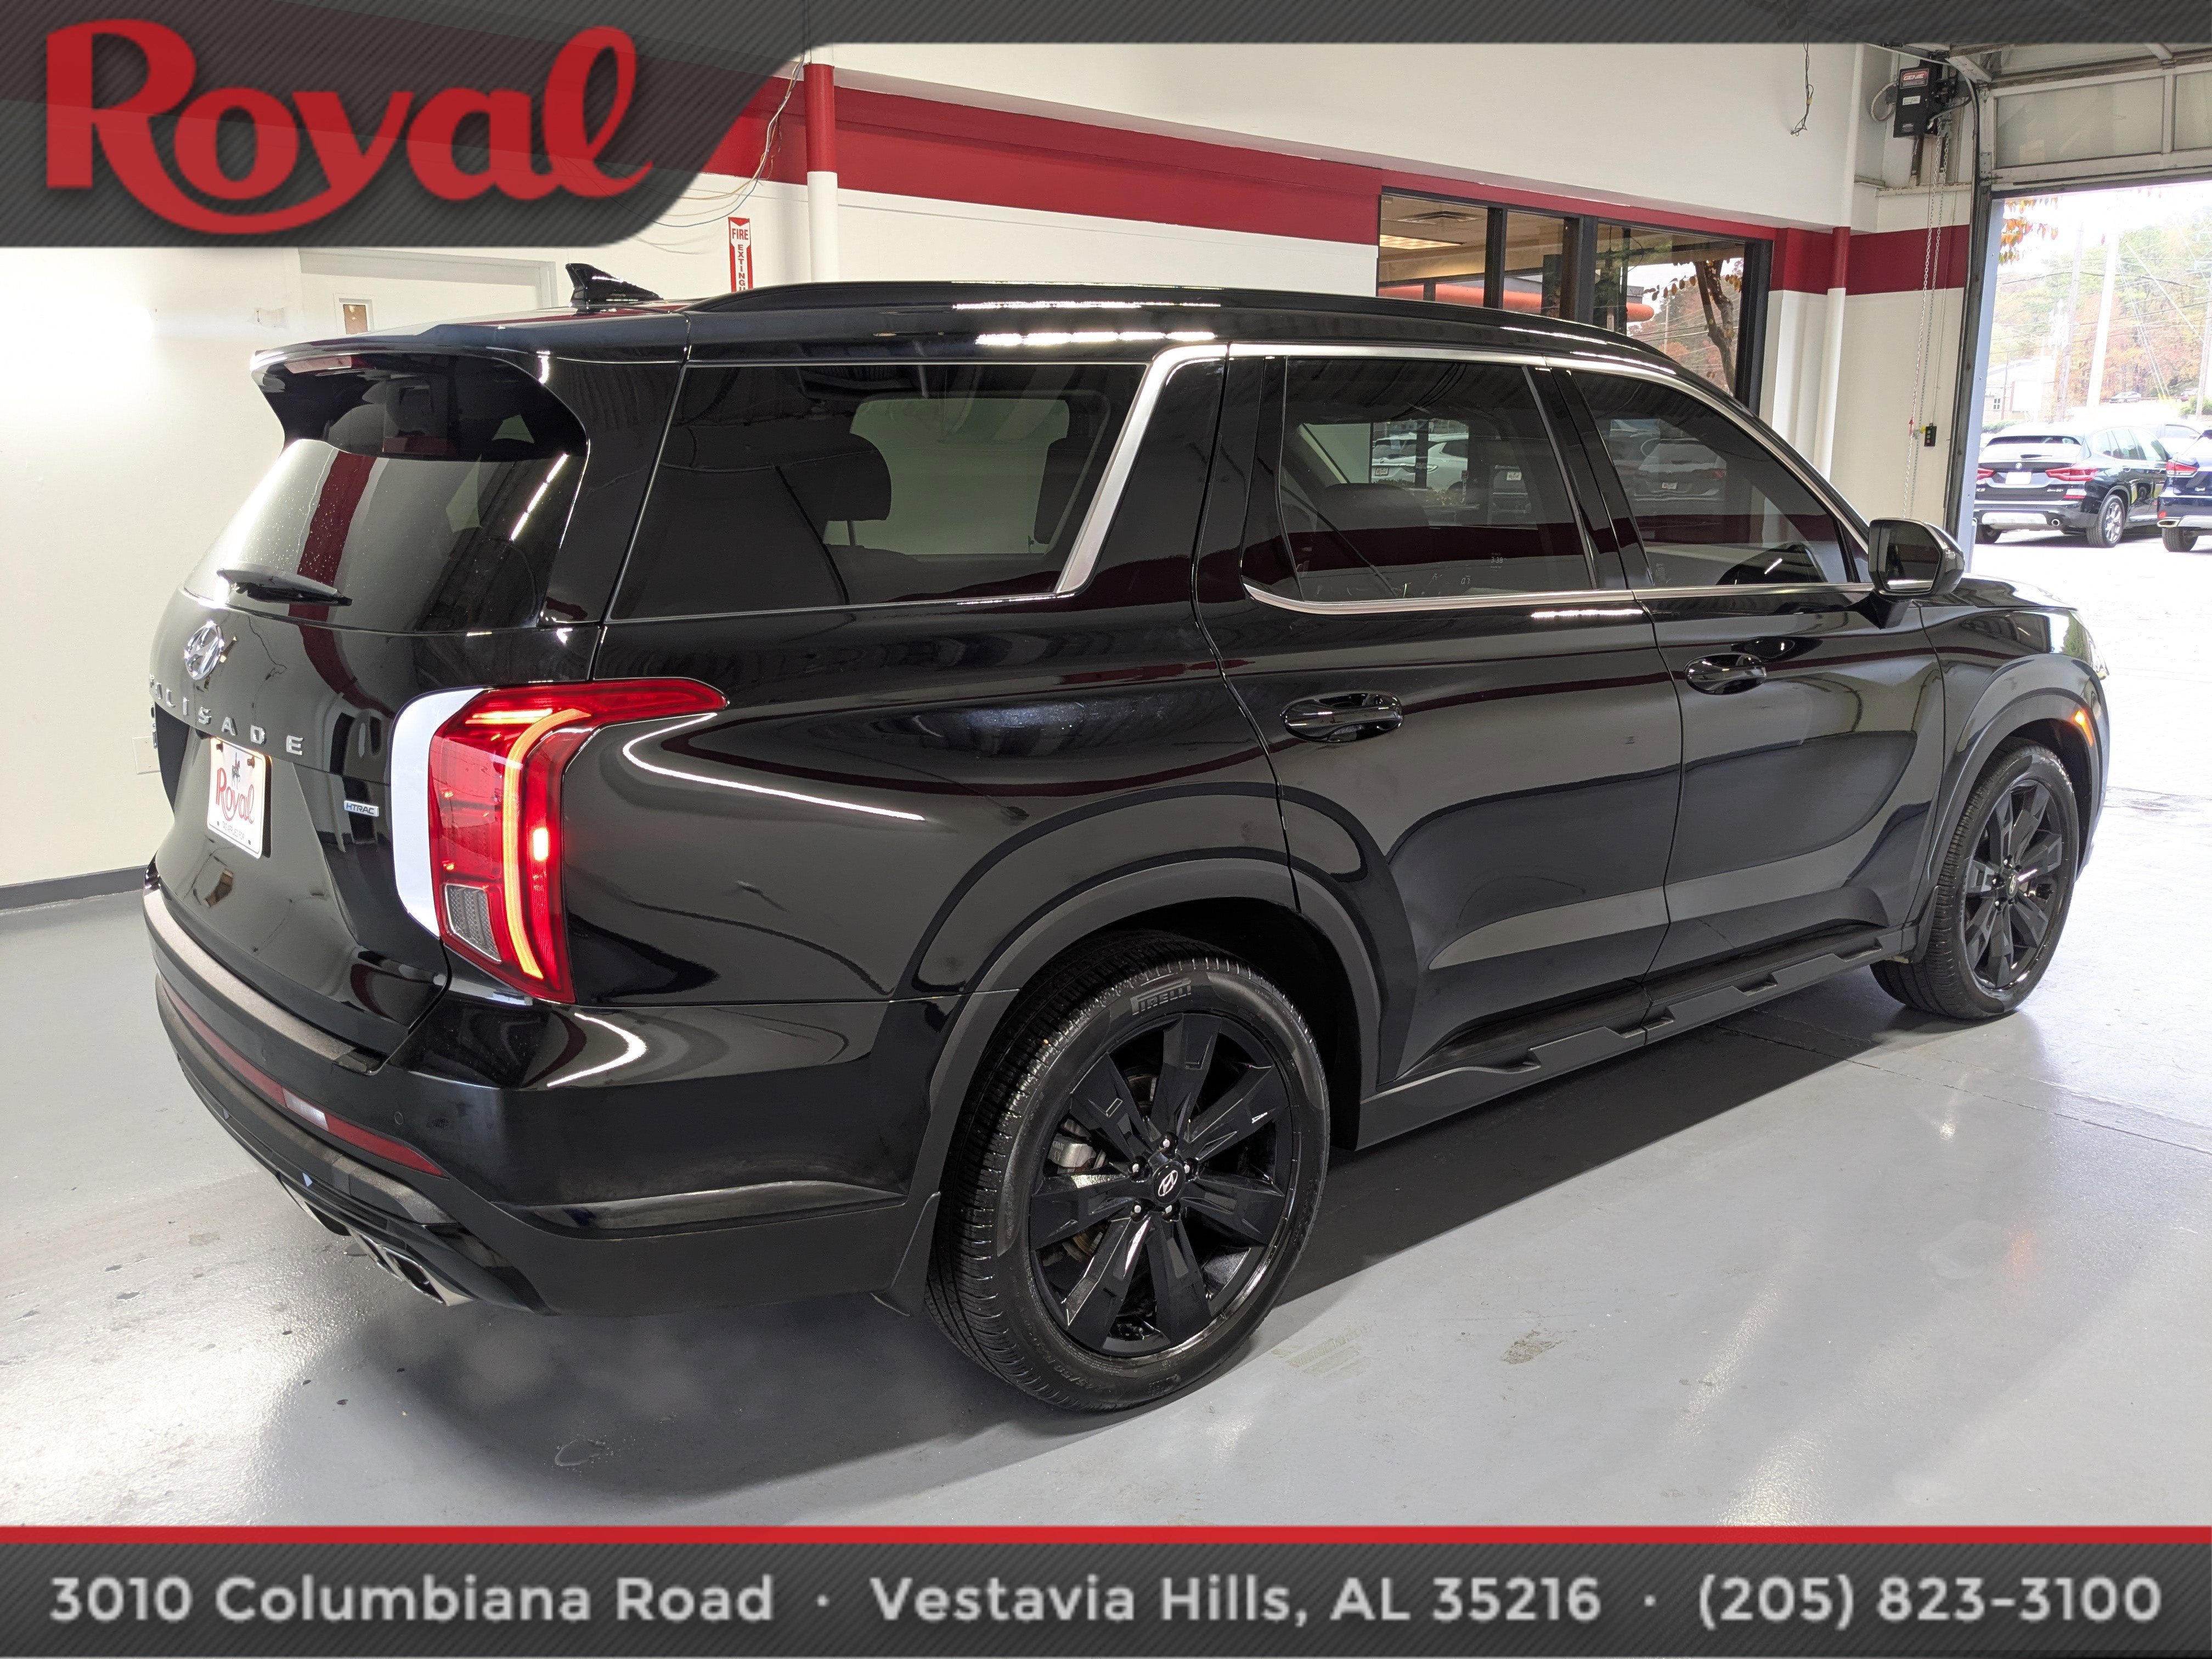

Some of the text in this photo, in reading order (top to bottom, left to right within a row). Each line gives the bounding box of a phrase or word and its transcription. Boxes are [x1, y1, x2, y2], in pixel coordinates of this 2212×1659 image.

[731, 228, 749, 240] FIRE
[149, 674, 304, 755] PALISADE
[216, 767, 255, 824] Royal
[346, 803, 375, 815] HTRAC
[1130, 977, 1192, 1015] PIRELLI
